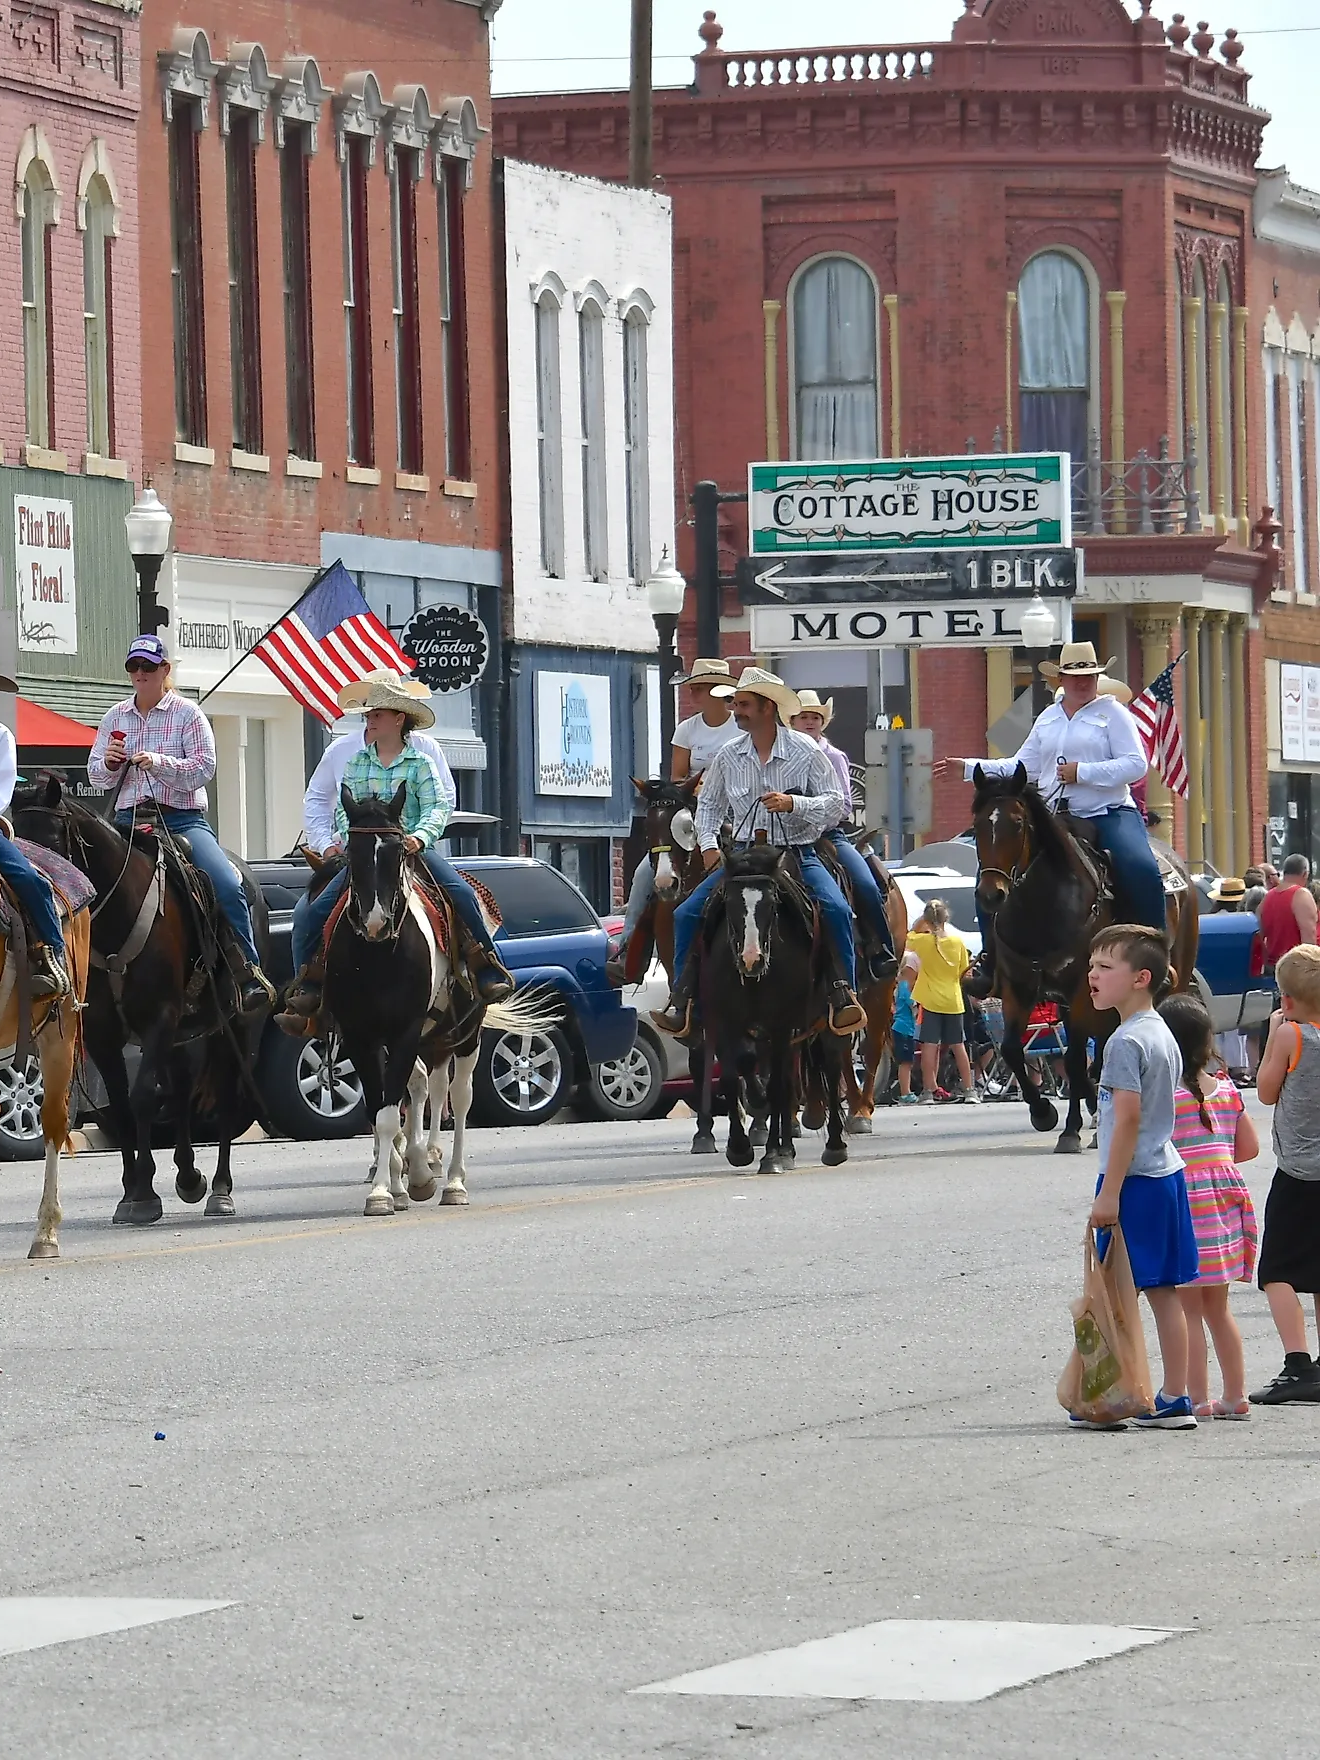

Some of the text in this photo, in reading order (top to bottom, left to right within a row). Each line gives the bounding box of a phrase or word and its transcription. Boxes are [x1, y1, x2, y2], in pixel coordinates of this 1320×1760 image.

[1034, 12, 1085, 36] BANK
[894, 482, 921, 492] THE
[773, 488, 1040, 526] COTTAGE HOUSE
[18, 505, 71, 550] Flint Hills
[31, 562, 64, 603] Floral
[966, 556, 977, 589] 1
[1080, 581, 1152, 600] ANK
[435, 629, 452, 637] THE
[790, 608, 1022, 641] MOTEL
[411, 638, 478, 655] Wooden
[418, 656, 471, 668] SPOON
